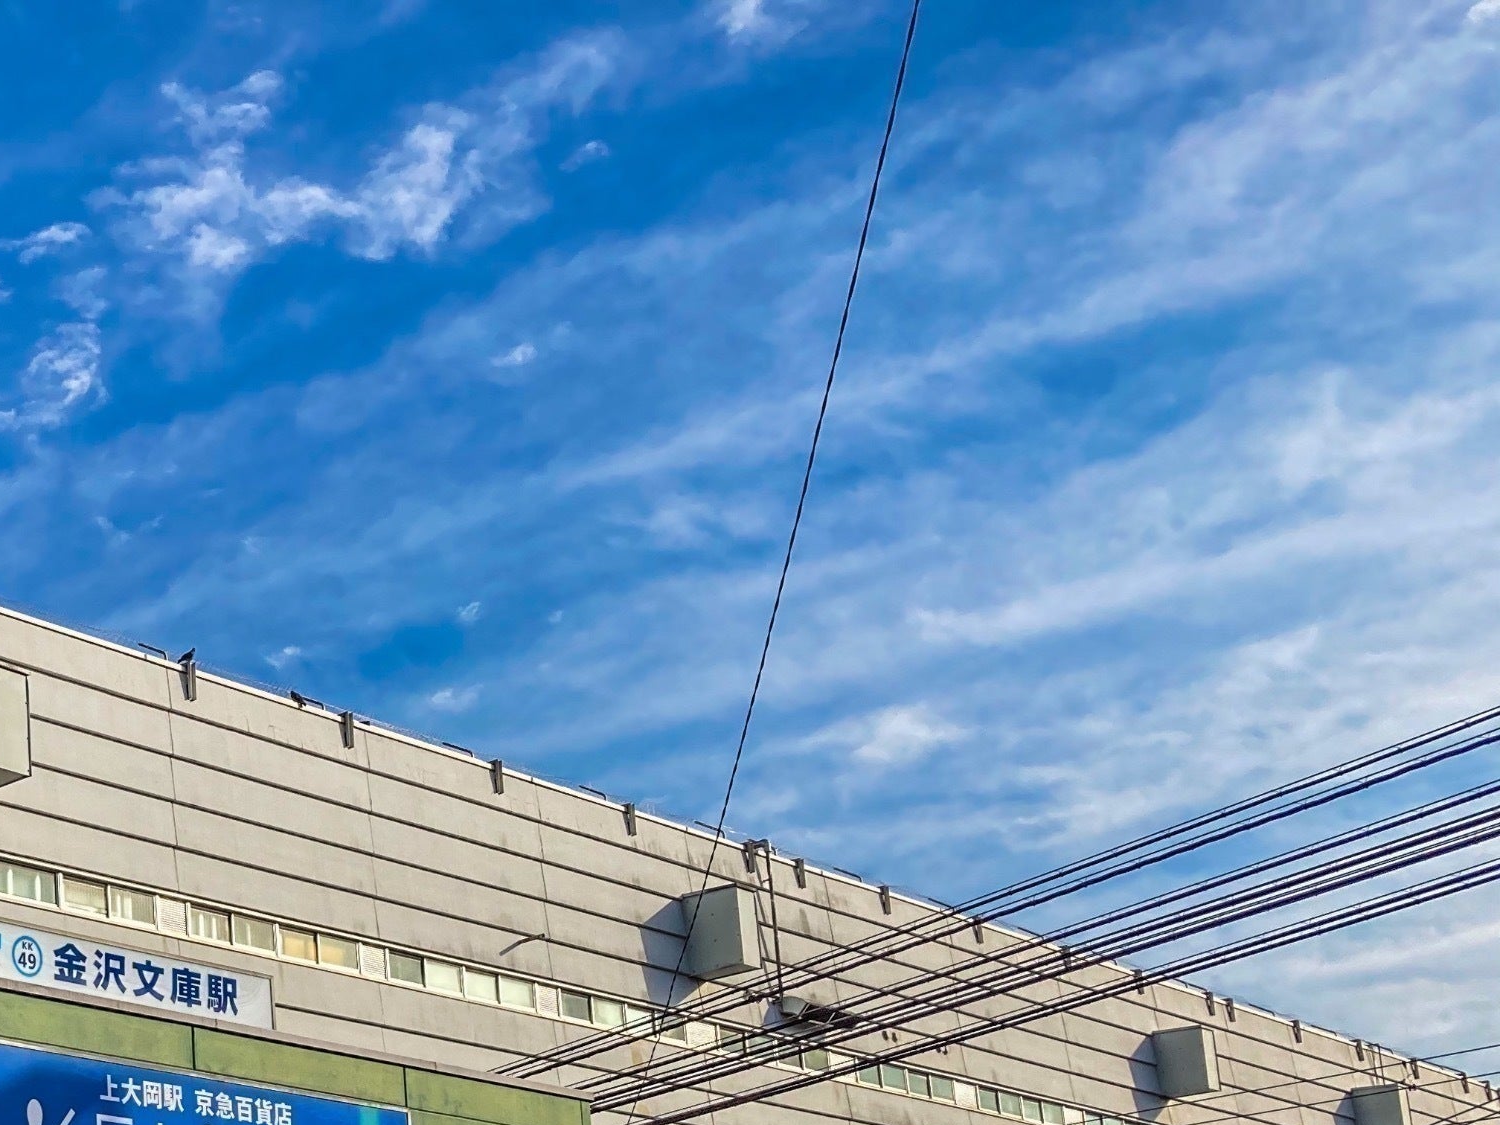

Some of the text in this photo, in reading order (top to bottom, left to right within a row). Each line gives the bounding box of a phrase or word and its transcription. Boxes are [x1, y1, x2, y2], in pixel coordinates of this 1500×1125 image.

[21, 940, 34, 952] KK
[17, 952, 37, 970] 49
[53, 943, 239, 1017] 金沢文庫駅
[99, 1073, 185, 1113] 上大岡駅
